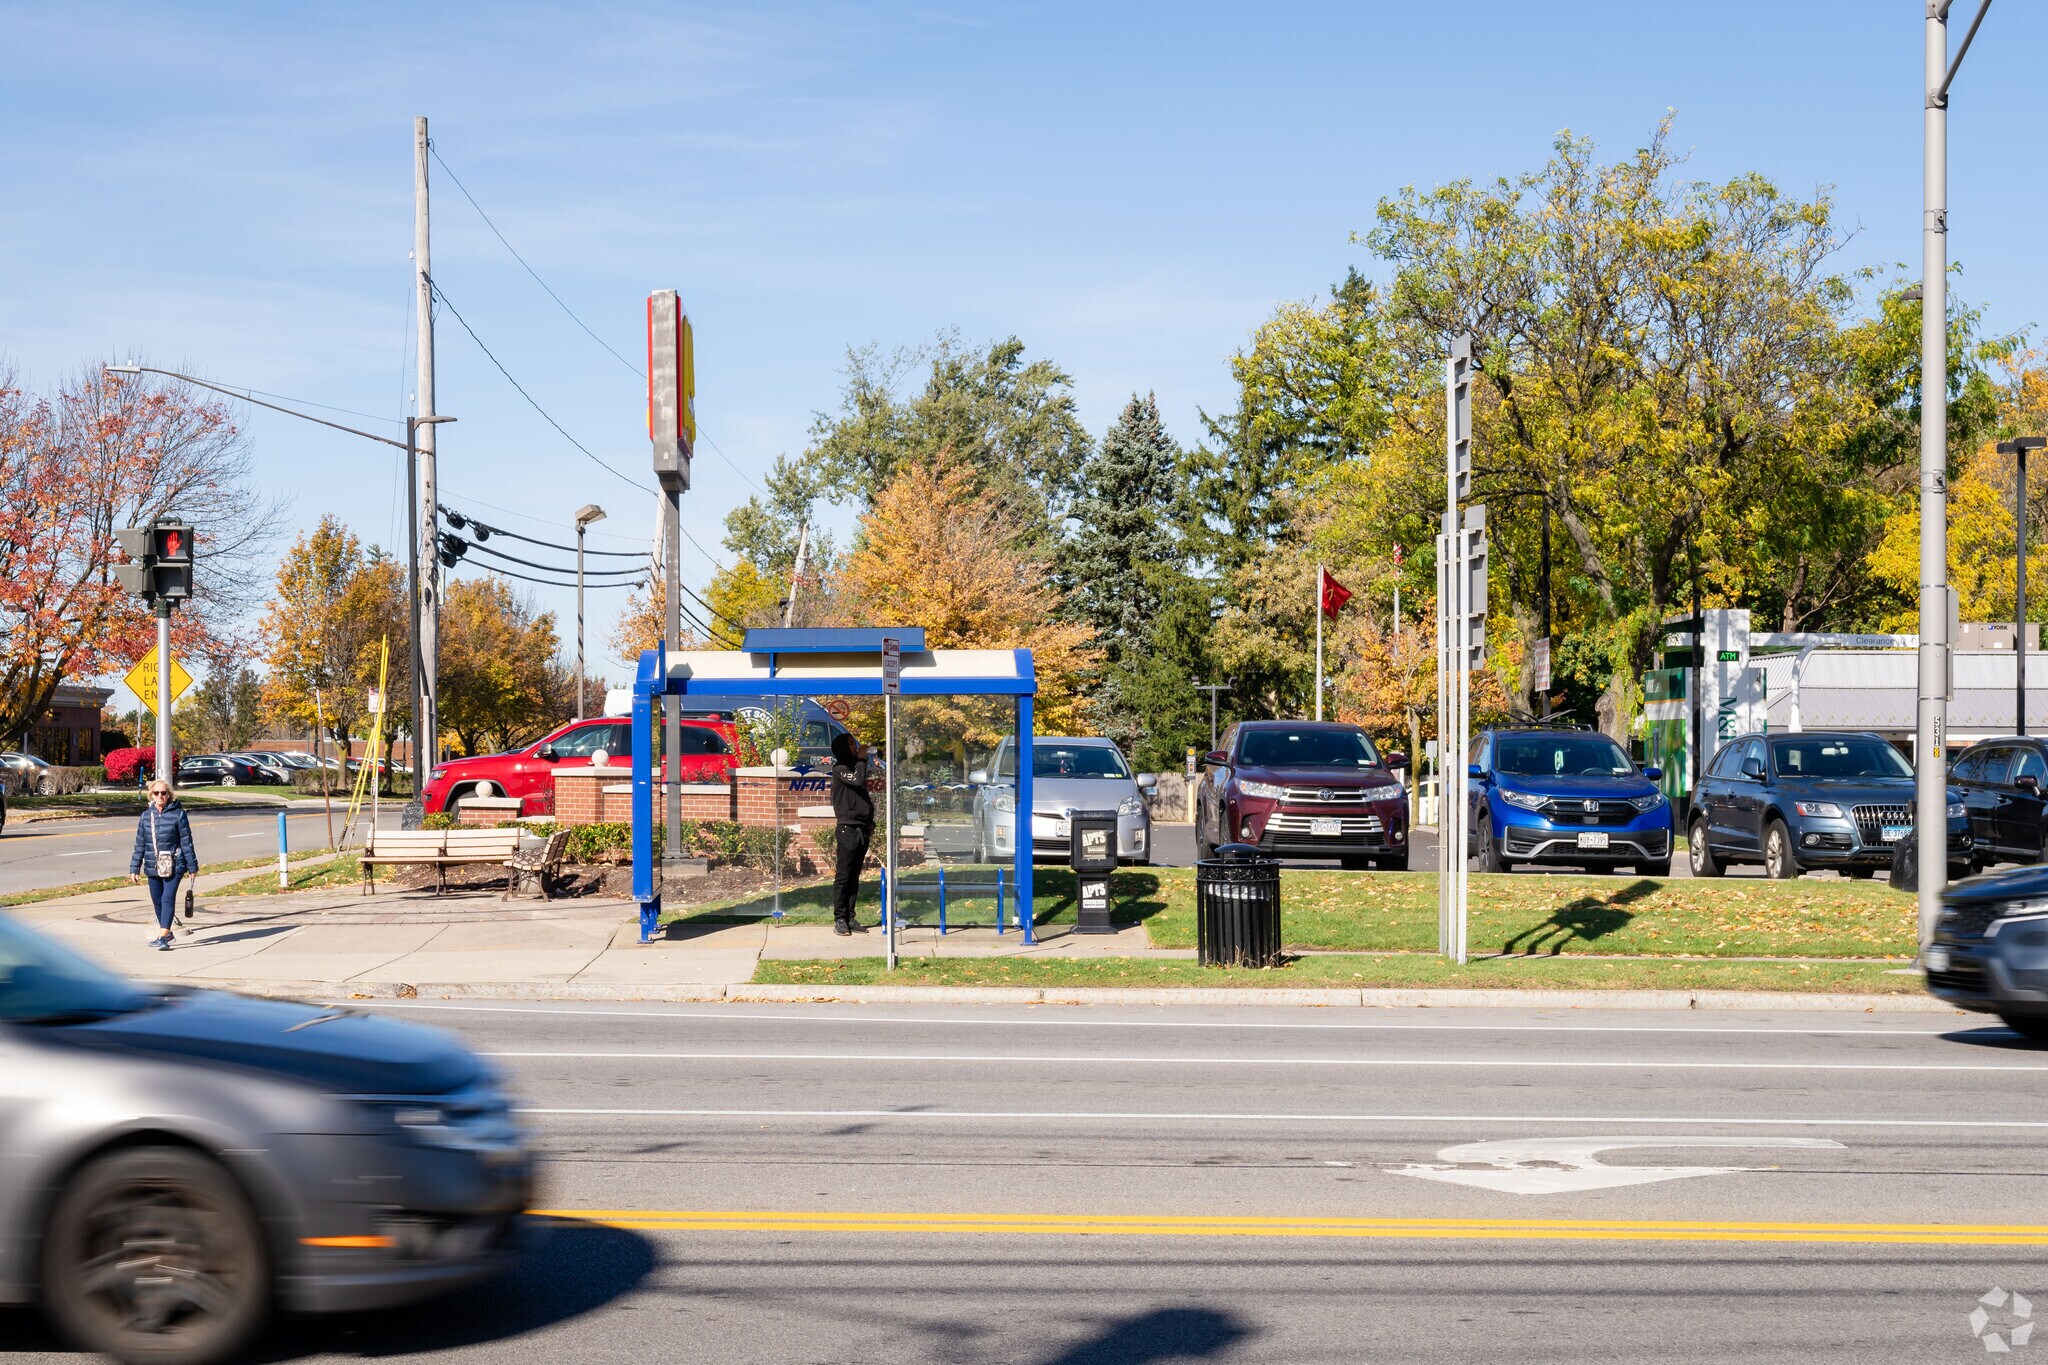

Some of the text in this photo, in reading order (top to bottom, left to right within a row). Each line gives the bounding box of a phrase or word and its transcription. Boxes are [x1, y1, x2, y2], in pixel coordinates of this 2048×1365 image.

[1856, 636, 1894, 645] Clearance
[1720, 652, 1737, 660] ATM
[1082, 831, 1106, 847] APTS
[1082, 883, 1106, 899] APTS
